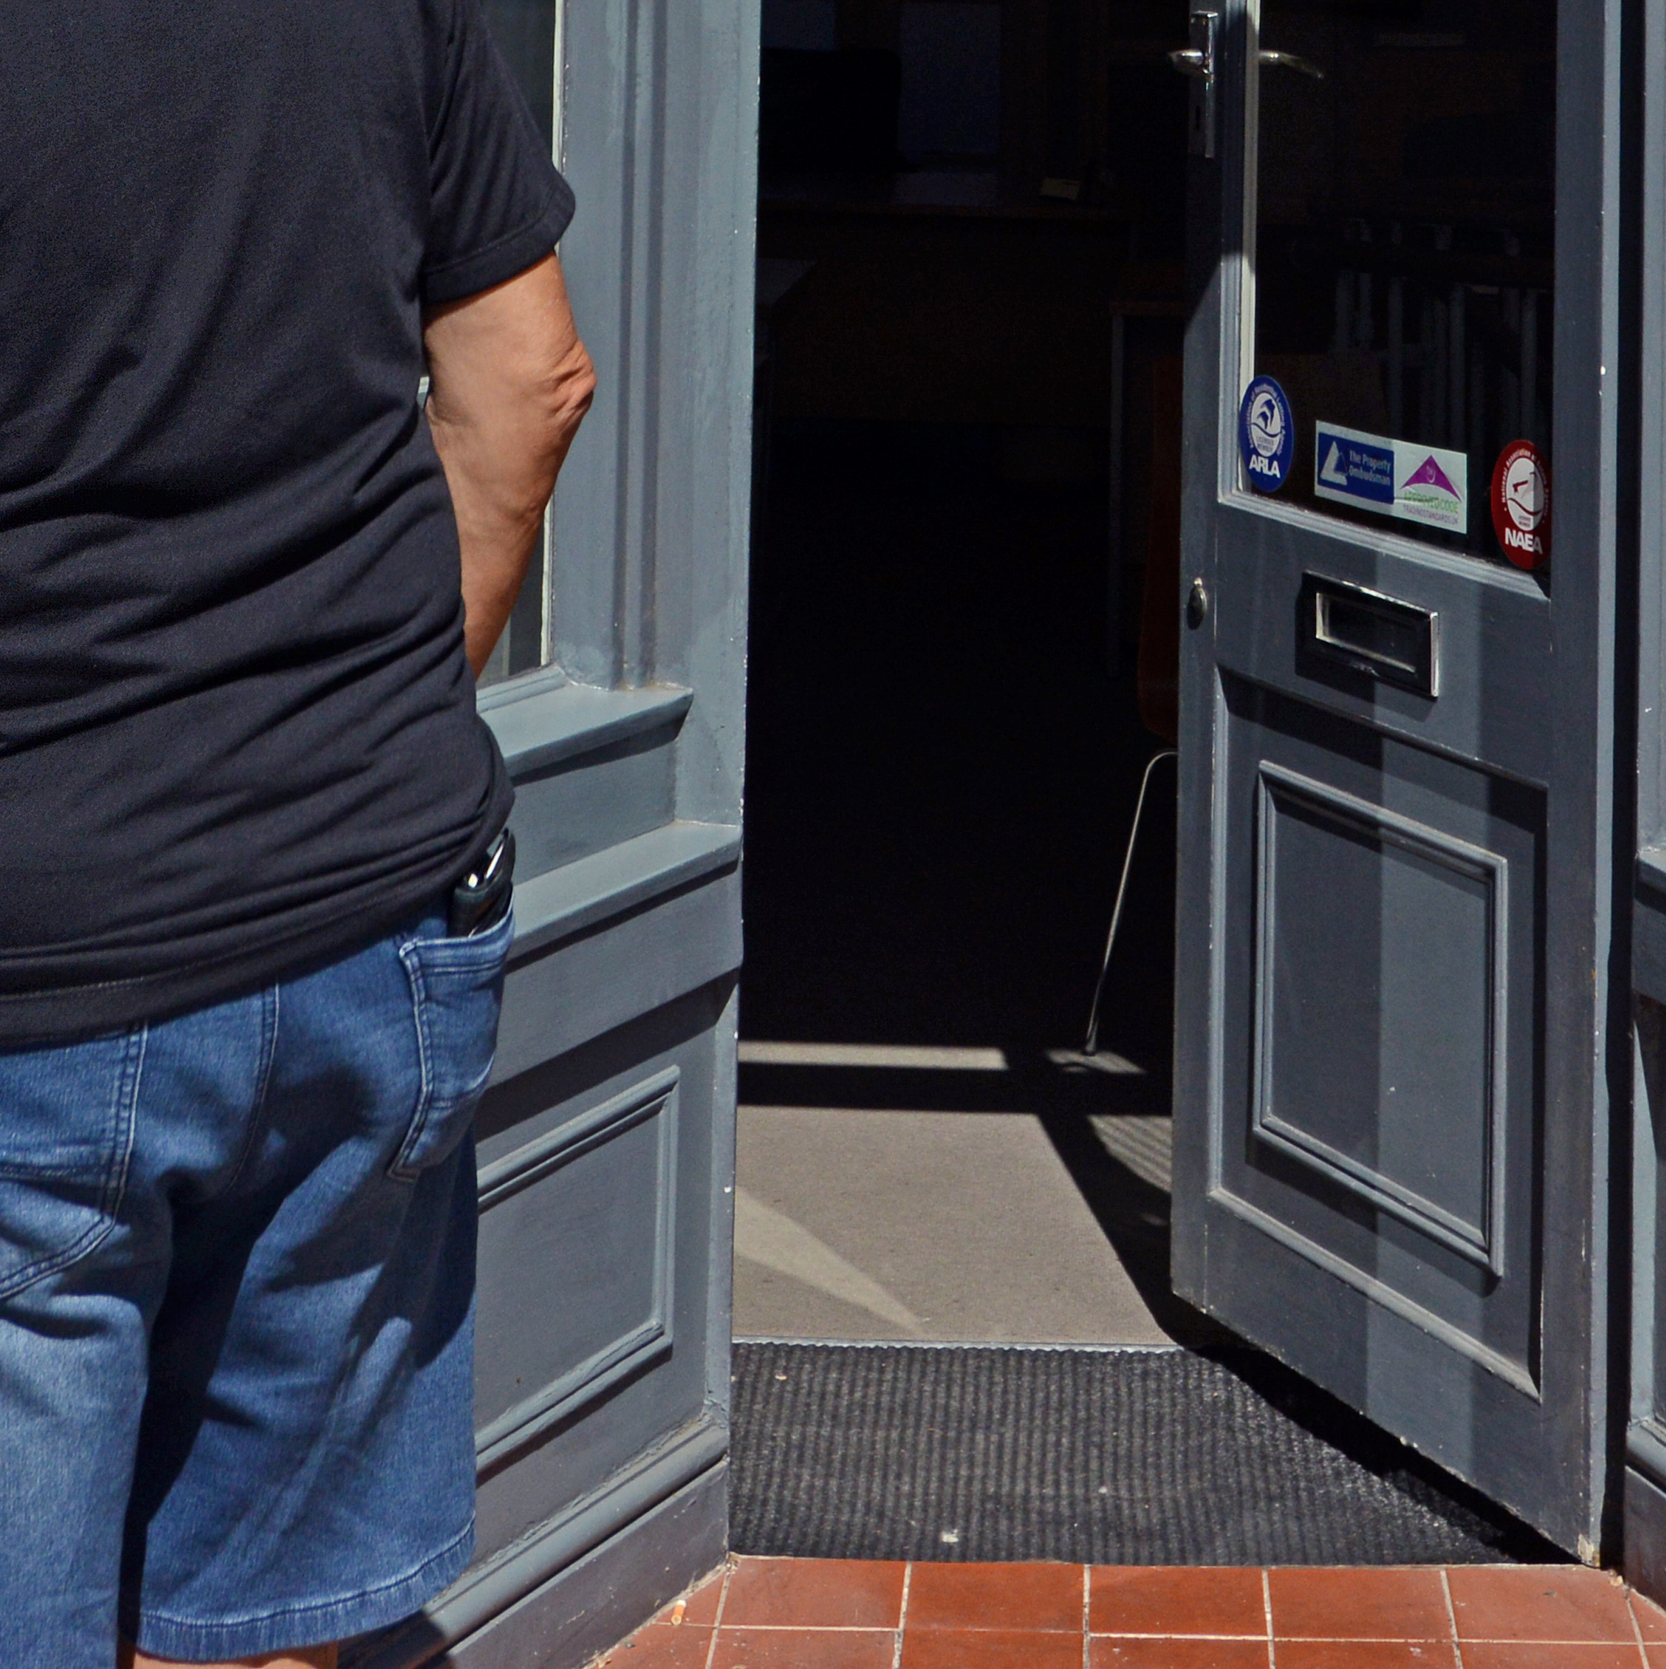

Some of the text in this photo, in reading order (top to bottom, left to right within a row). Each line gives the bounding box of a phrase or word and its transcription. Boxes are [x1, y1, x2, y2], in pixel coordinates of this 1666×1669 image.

[1249, 454, 1280, 478] ARLA
[1350, 450, 1391, 474] The Property
[1349, 466, 1391, 485] Ombudsman
[1505, 527, 1543, 554] NAEA
